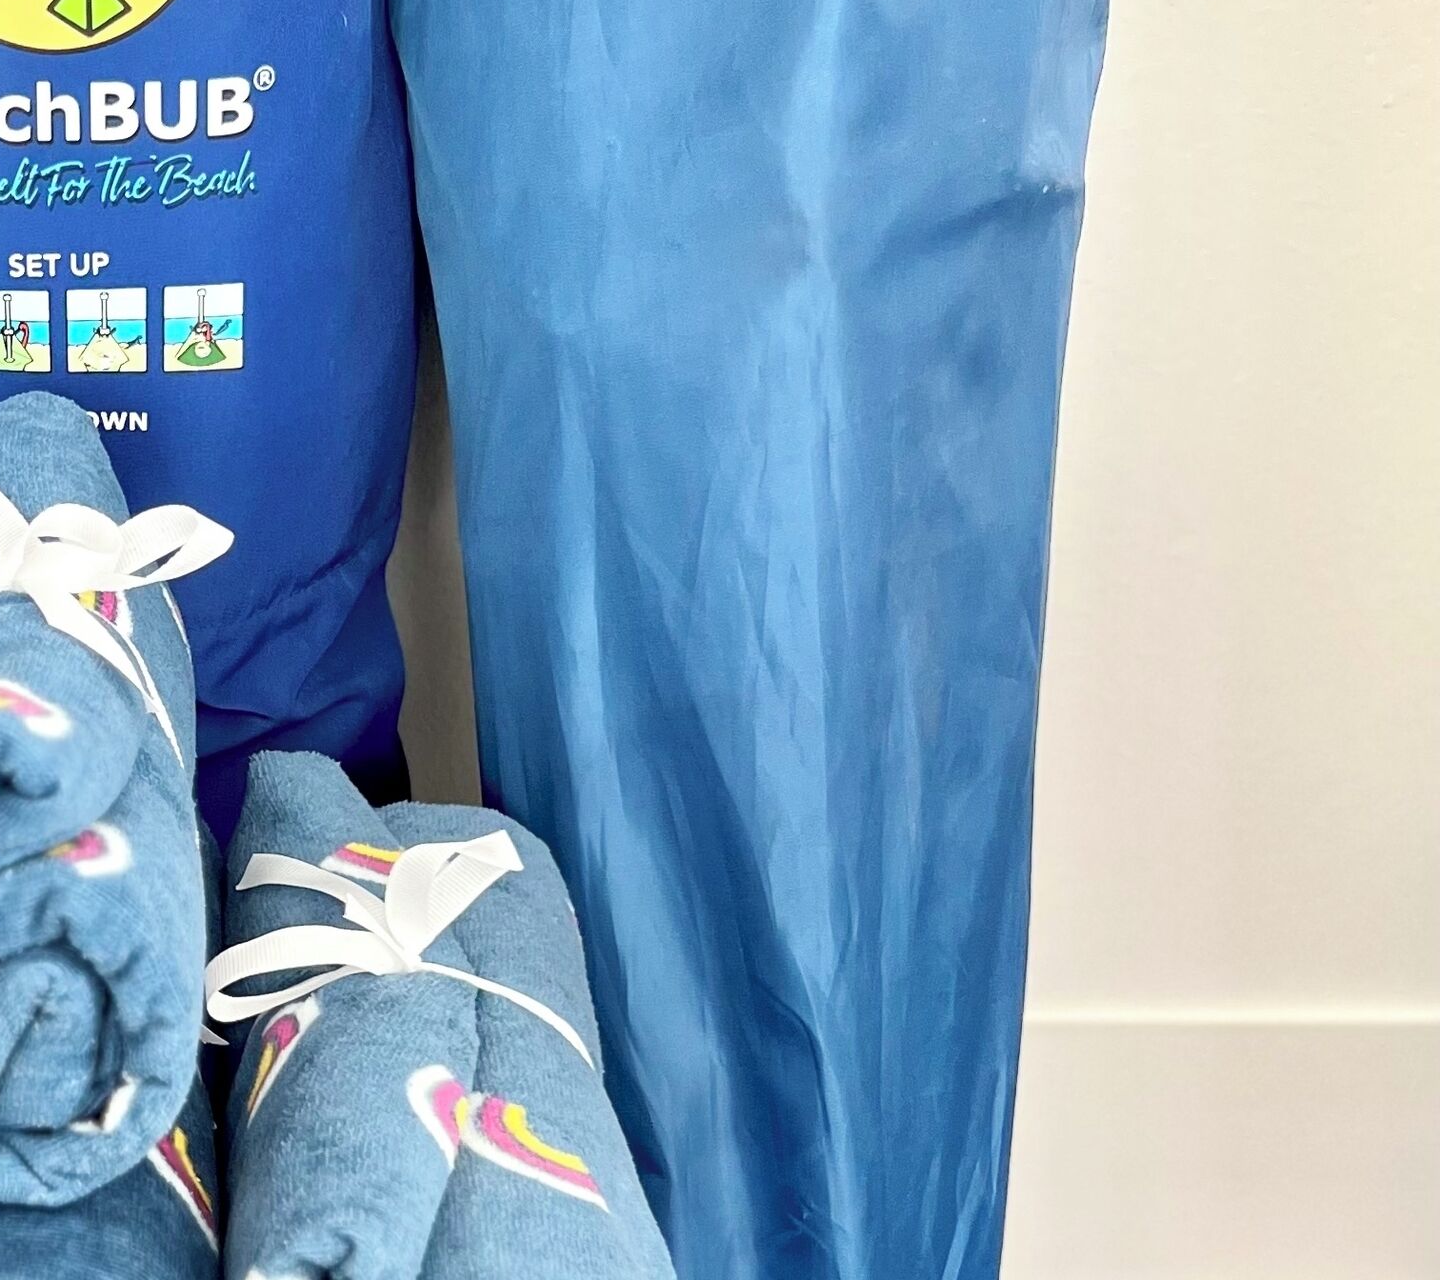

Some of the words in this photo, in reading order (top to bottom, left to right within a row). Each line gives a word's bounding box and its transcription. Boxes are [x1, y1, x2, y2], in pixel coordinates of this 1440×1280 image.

[41, 160, 92, 207] For
[94, 153, 152, 205] The
[154, 150, 257, 206] Beach
[8, 253, 61, 278] SET
[69, 252, 110, 277] UP
